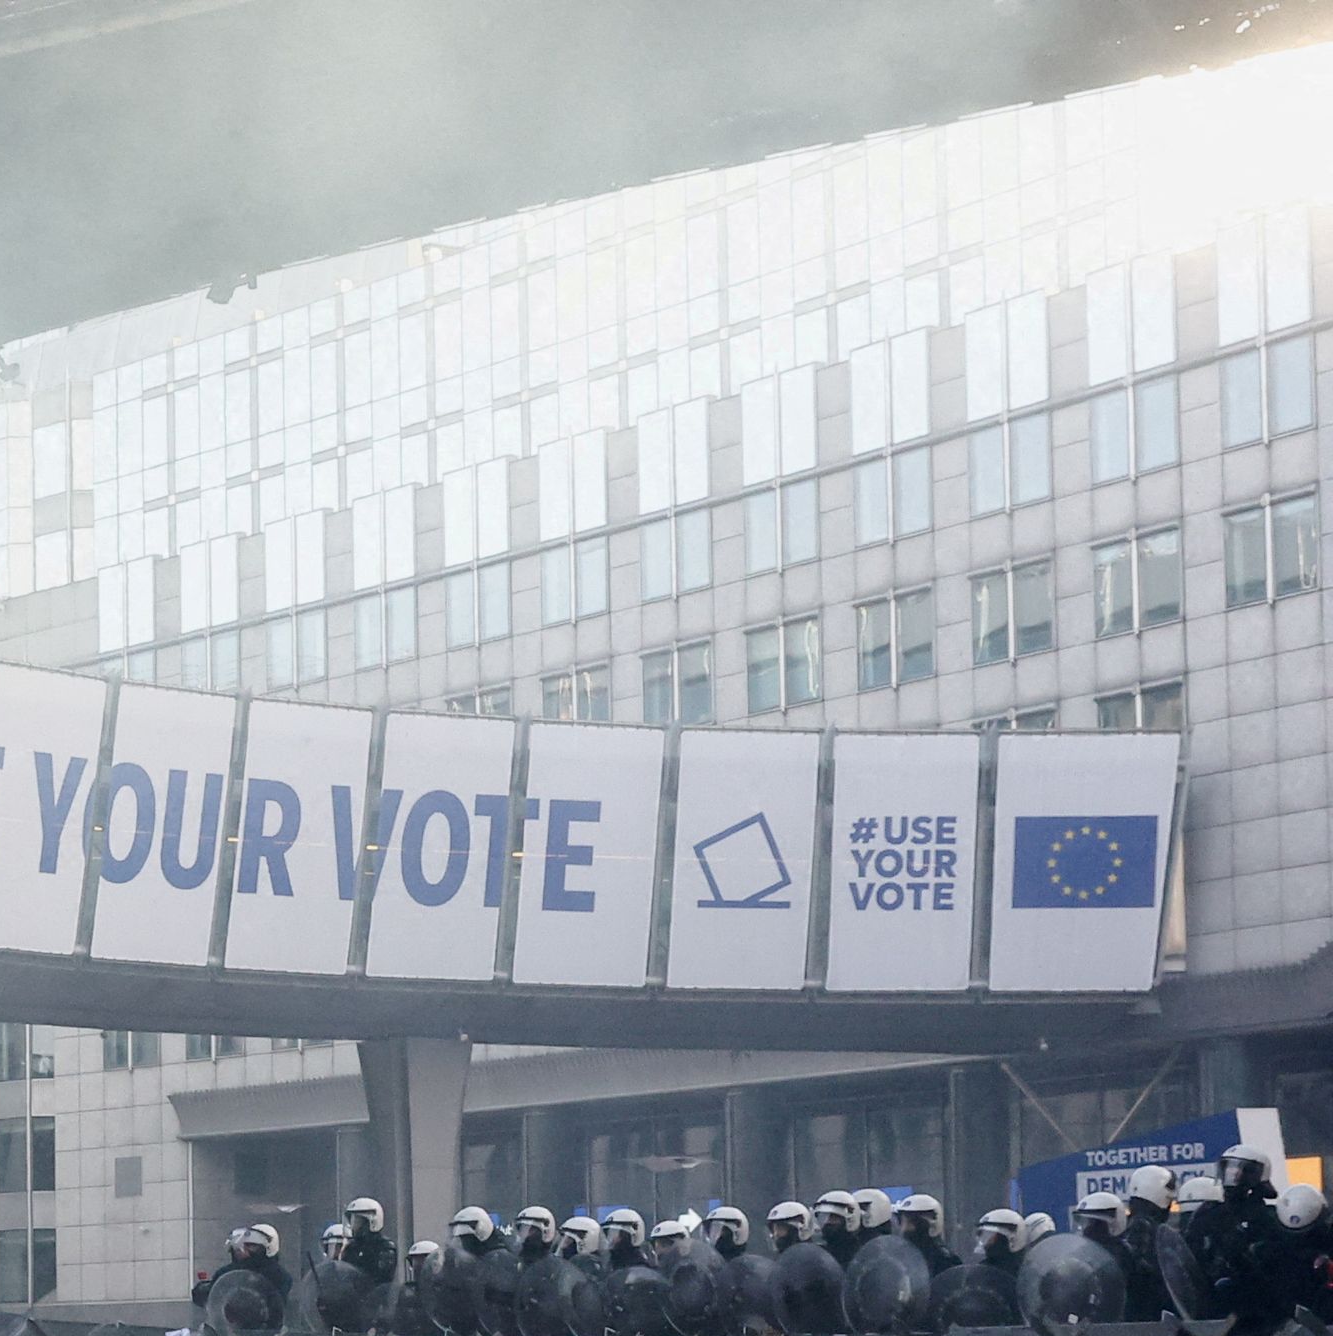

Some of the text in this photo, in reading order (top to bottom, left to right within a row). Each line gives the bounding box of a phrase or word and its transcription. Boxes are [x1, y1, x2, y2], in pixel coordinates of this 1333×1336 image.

[33, 751, 302, 897] YOUR
[331, 785, 602, 912] VOTE
[849, 816, 957, 844] #USE
[851, 849, 957, 878] YOUR
[849, 882, 955, 911] VOTE
[1085, 1142, 1205, 1167] TOGETHER FOR
